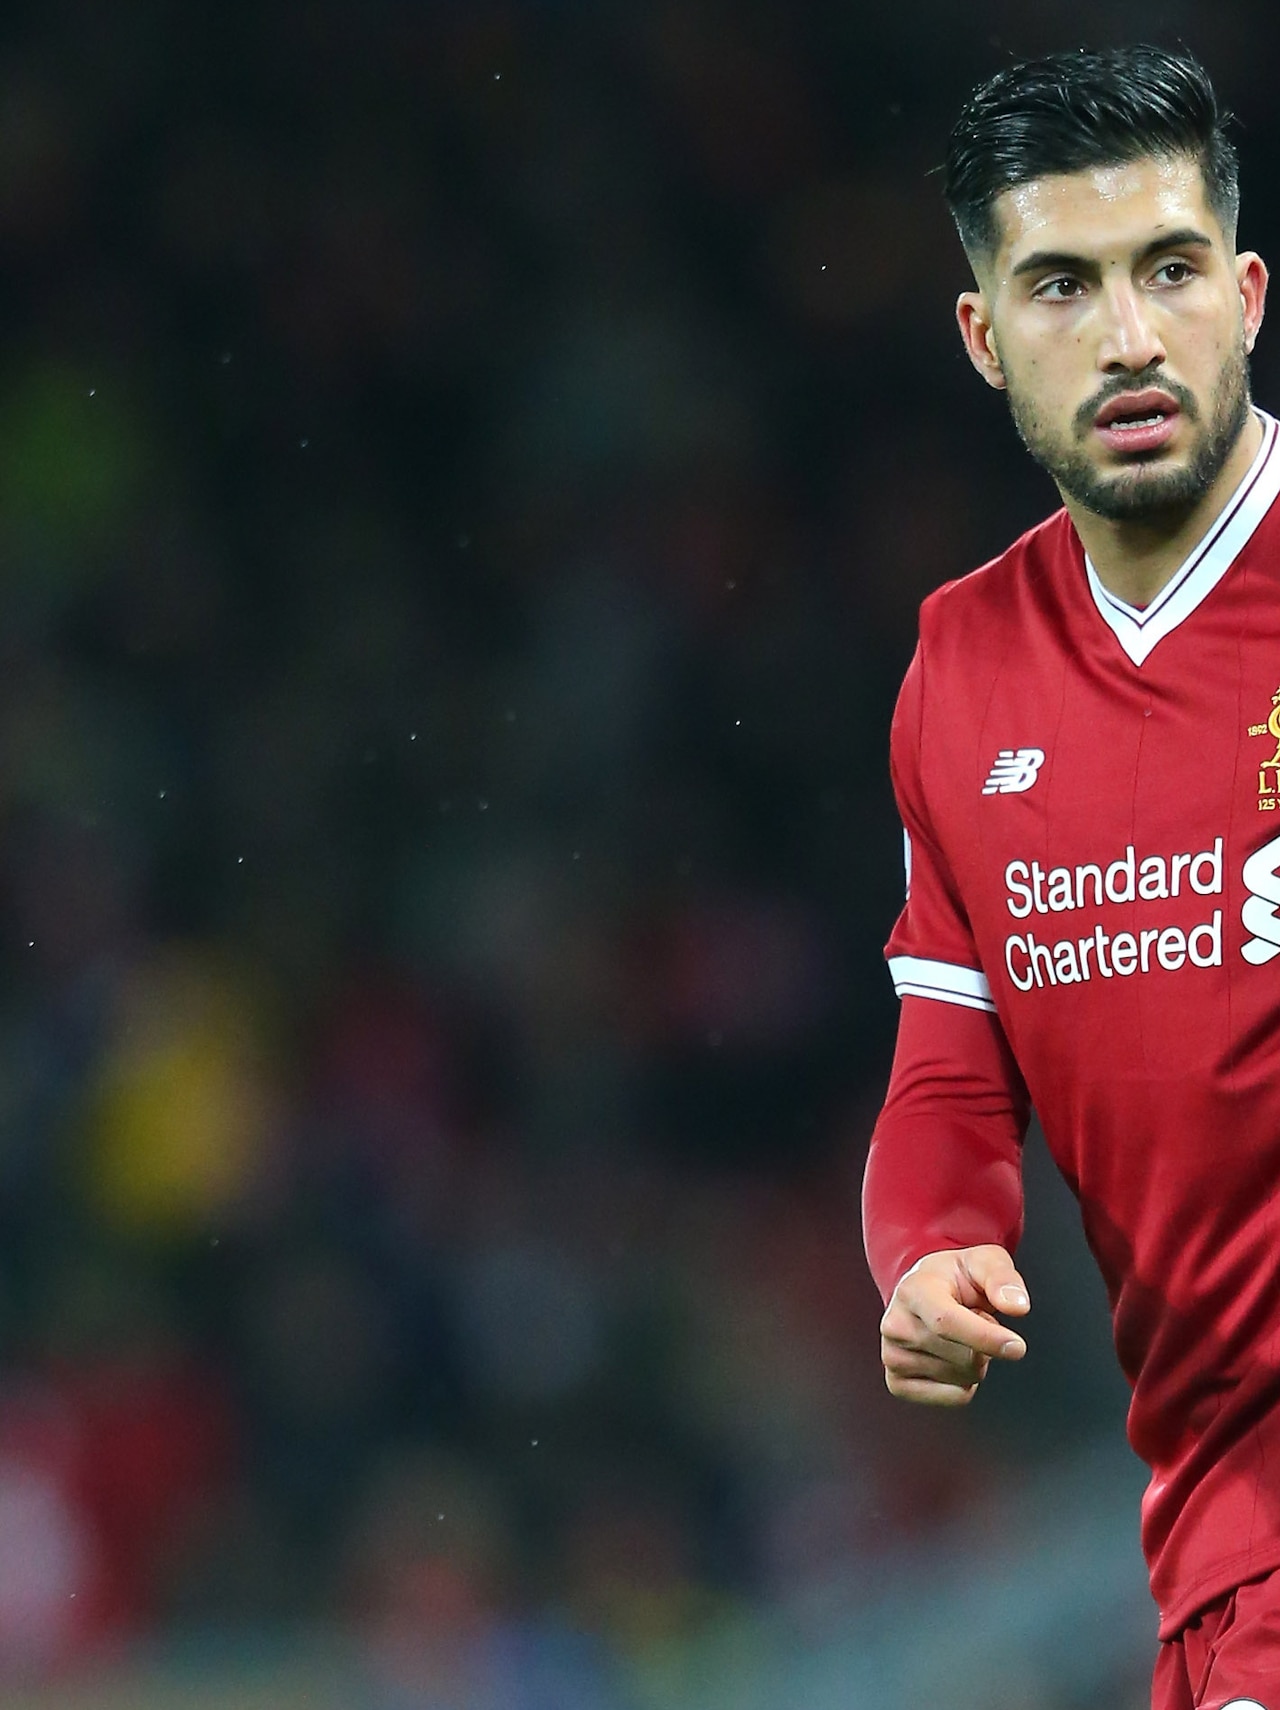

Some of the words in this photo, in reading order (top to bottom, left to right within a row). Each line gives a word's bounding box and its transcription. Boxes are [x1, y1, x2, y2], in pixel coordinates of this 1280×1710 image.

[1247, 723, 1268, 737] 1892
[1258, 799, 1276, 811] 125
[1005, 837, 1223, 918] Standard
[1005, 909, 1222, 991] Chartered
